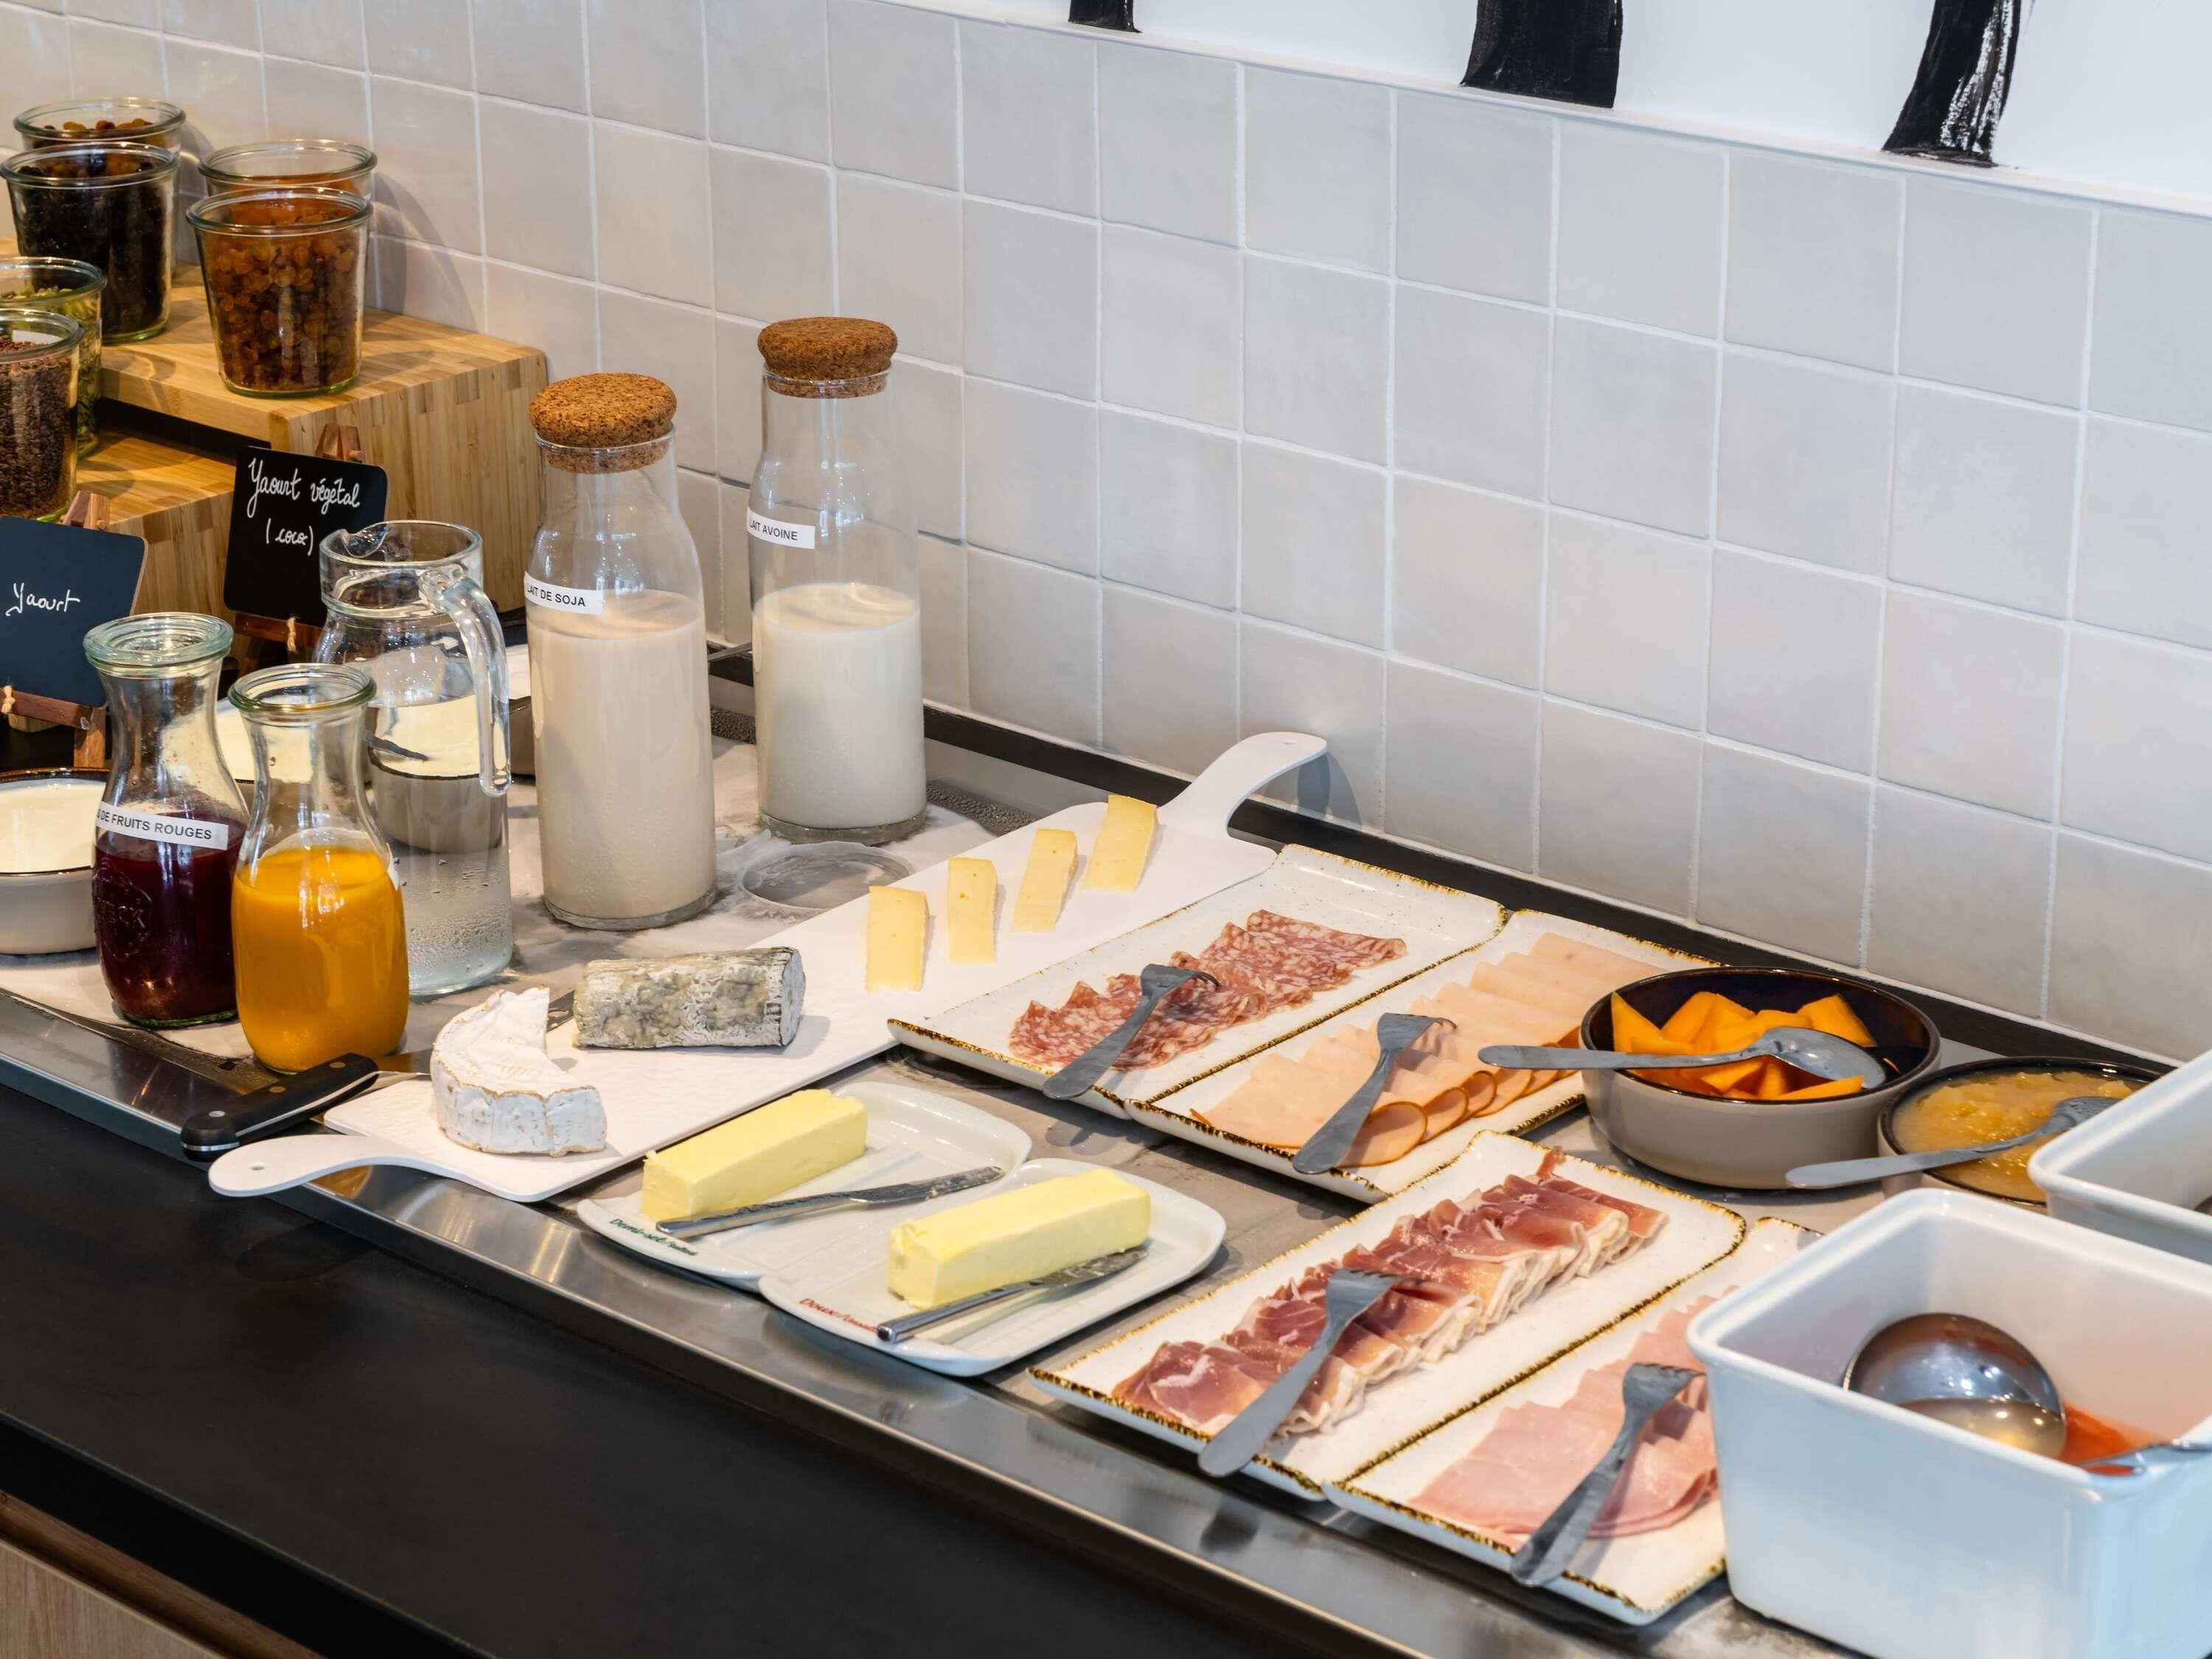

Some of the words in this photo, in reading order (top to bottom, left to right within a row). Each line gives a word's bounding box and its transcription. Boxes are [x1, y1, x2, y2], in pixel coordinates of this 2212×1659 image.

[247, 457, 302, 518] Yaourt
[310, 477, 360, 515] végétal
[762, 524, 799, 540] AVOINE
[5, 582, 81, 616] Yaourt
[540, 589, 552, 602] DE
[554, 594, 585, 607] SOJA
[101, 810, 110, 822] DE
[111, 814, 151, 831] FRUITS
[155, 823, 212, 840] ROUGES
